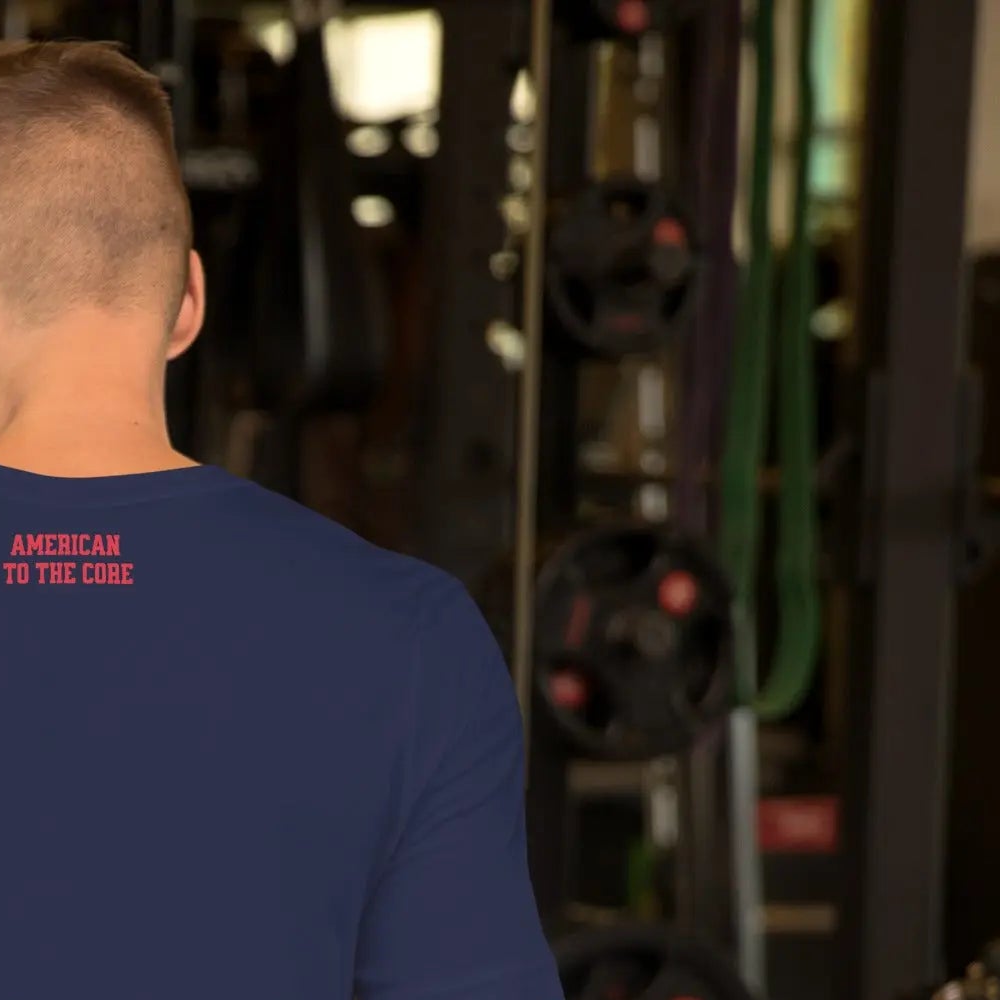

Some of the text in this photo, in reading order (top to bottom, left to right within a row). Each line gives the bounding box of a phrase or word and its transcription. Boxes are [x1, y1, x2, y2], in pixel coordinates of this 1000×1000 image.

[10, 534, 121, 556] AMERICAN
[3, 562, 133, 585] TO THE CORE
